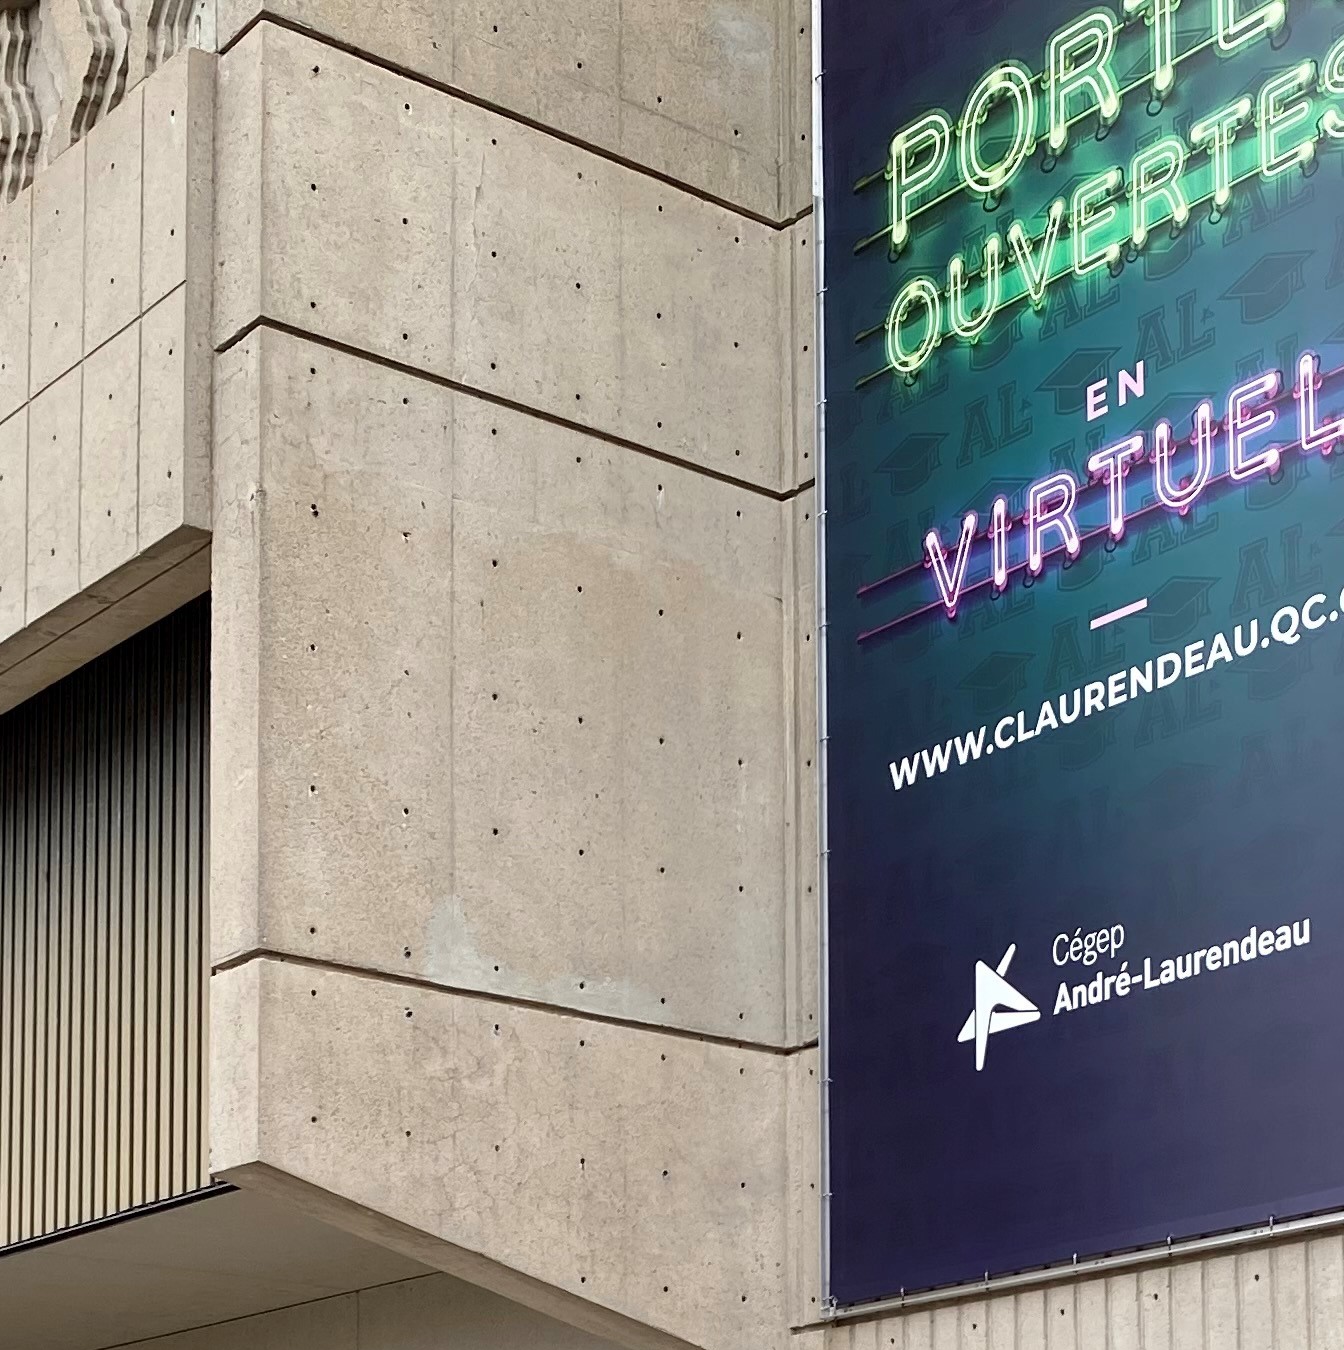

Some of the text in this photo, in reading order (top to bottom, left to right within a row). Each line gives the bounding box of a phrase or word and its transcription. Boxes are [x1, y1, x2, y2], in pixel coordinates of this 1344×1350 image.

[1136, 290, 1216, 374] AL
[956, 381, 1033, 468] AL
[1087, 361, 1145, 421] EN
[1052, 922, 1126, 968] Cégep
[1053, 918, 1311, 1016] André-Laurendeau
